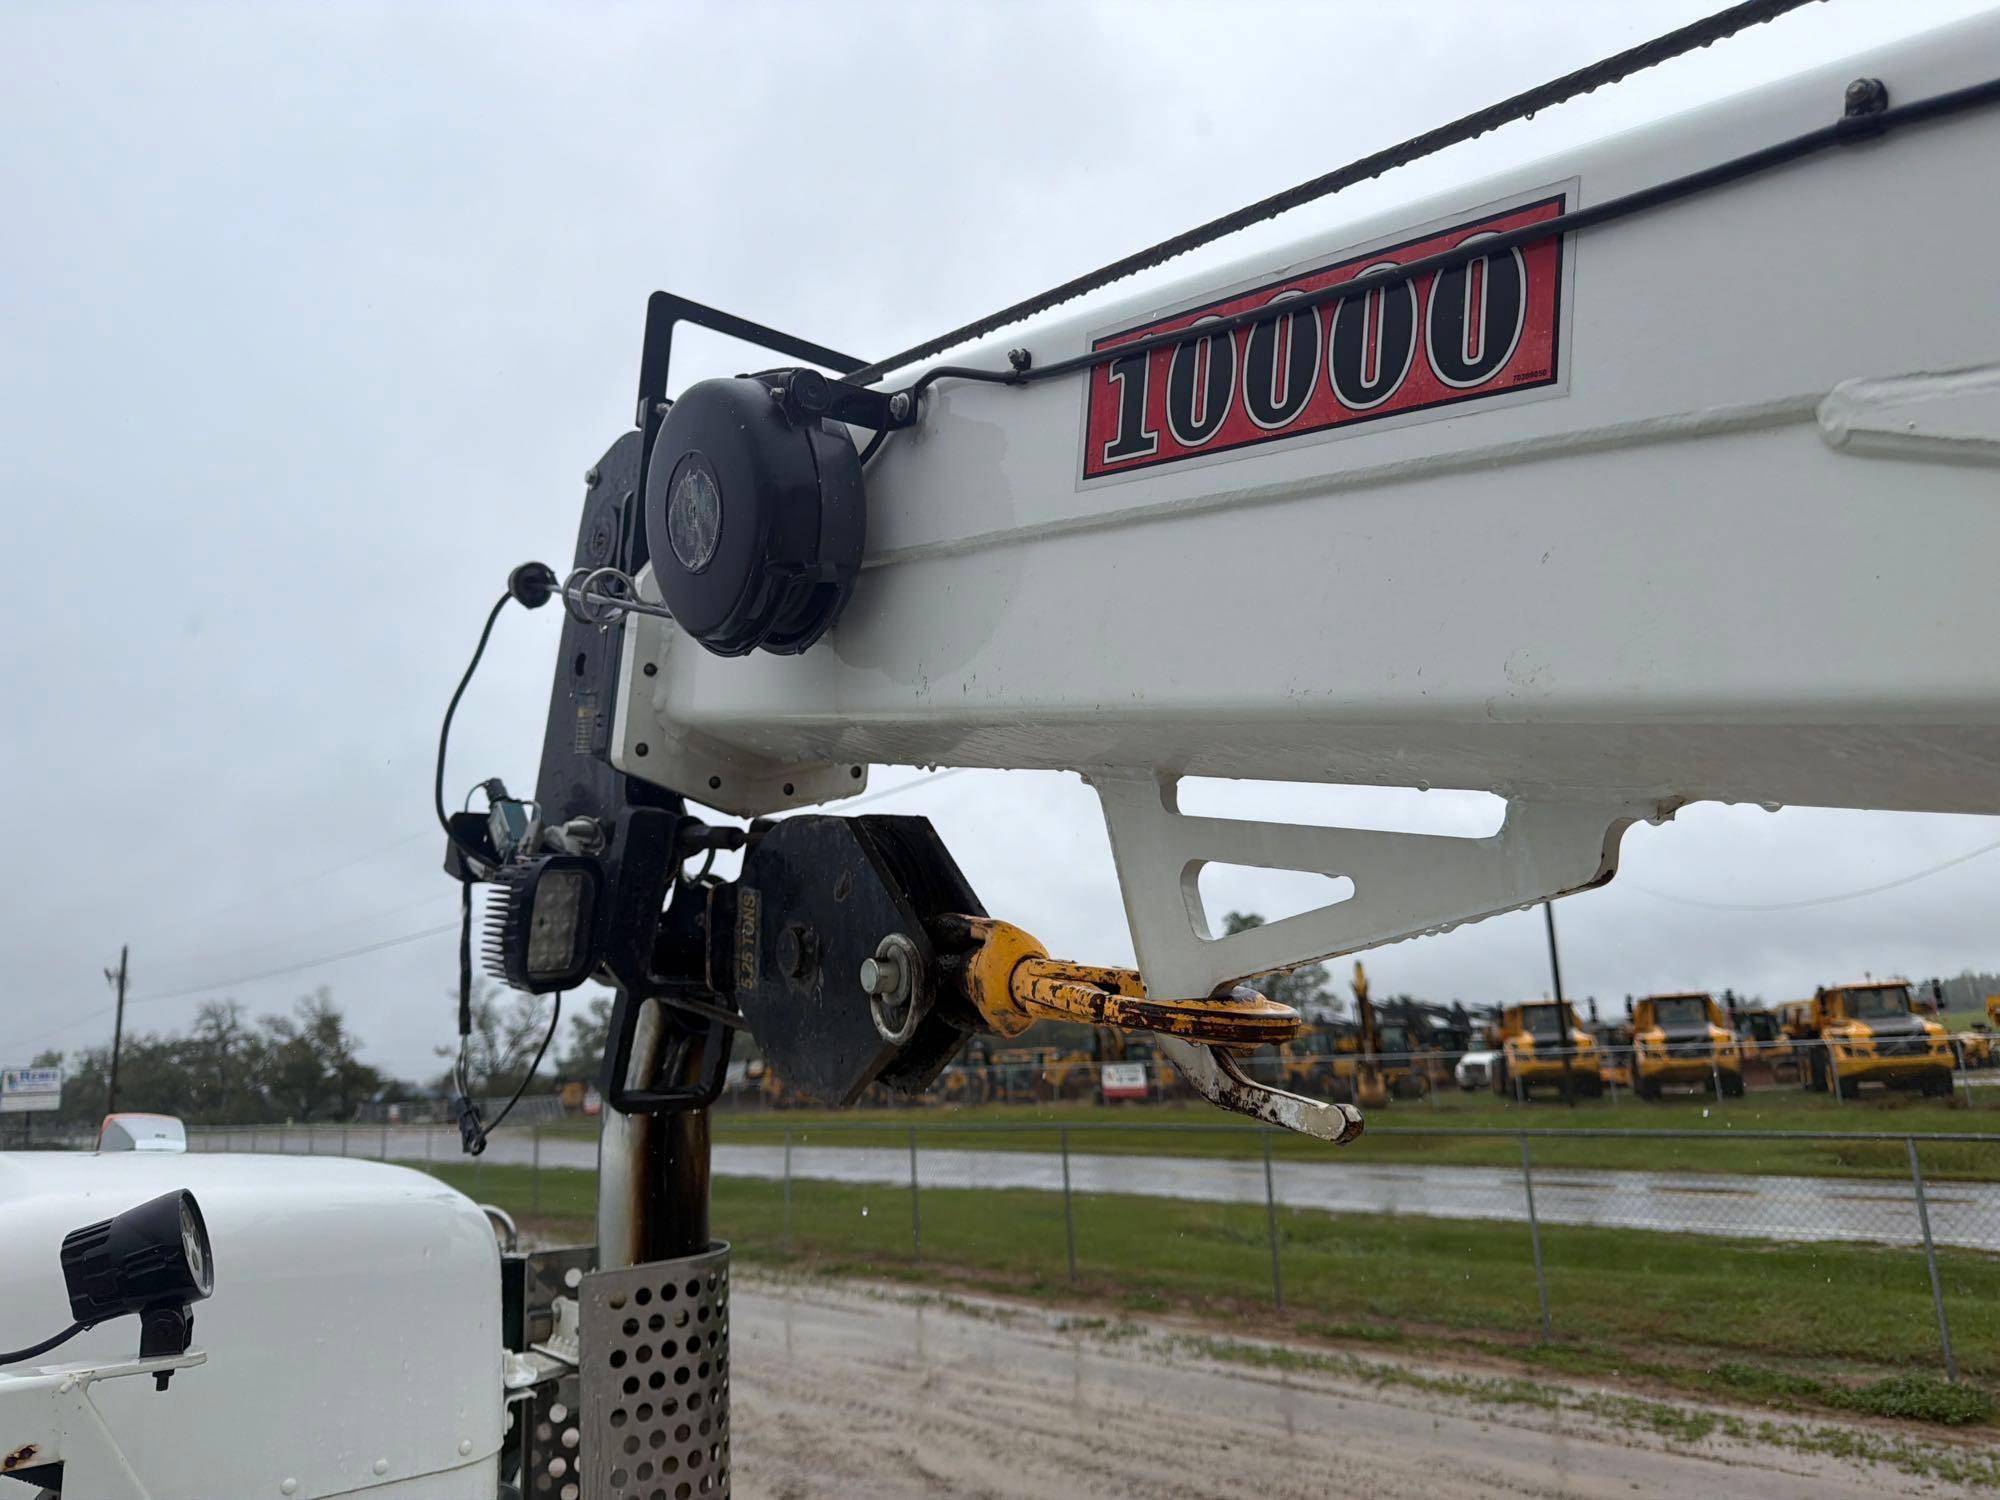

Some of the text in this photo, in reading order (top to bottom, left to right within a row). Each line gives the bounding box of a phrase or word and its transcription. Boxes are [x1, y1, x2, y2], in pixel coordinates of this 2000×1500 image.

[1103, 231, 1527, 465] 10000
[740, 895, 756, 990] 5.25 TONS
